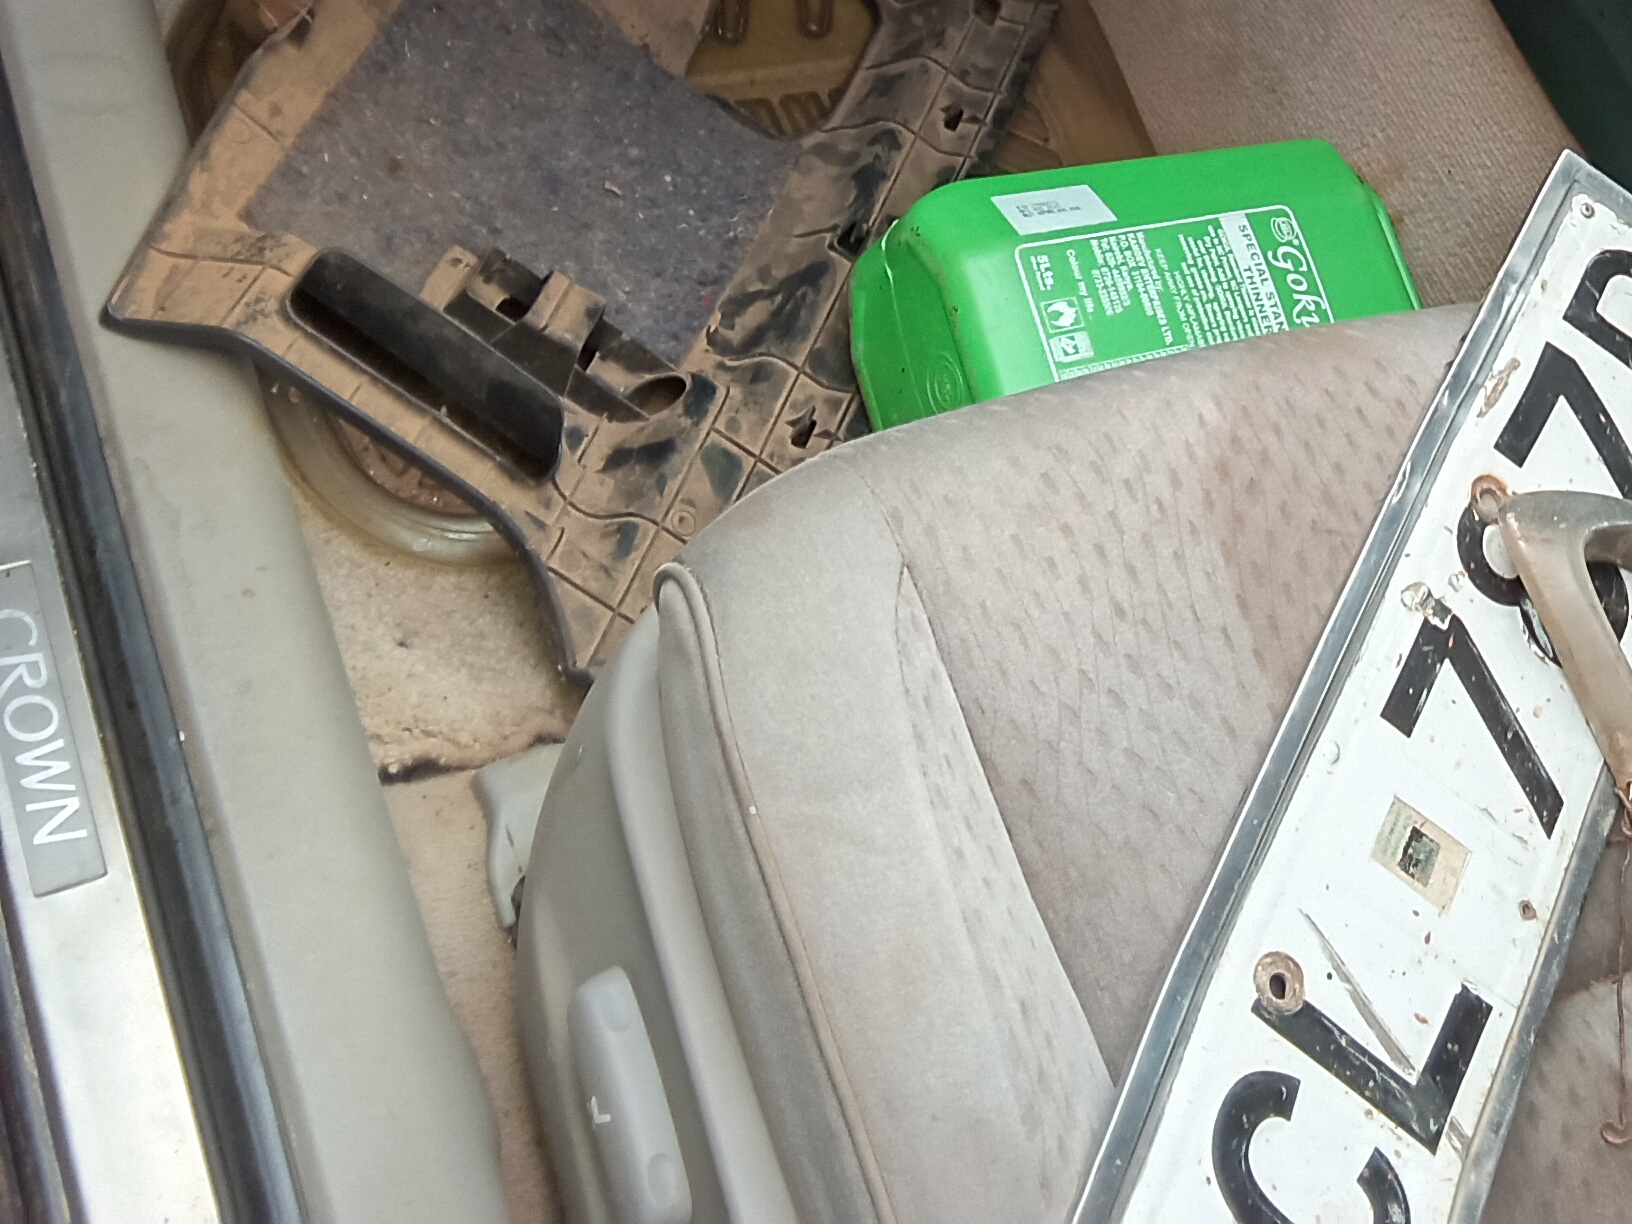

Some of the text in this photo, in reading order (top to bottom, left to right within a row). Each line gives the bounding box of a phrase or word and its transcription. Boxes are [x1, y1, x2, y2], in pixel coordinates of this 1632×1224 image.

[1065, 248, 1083, 280] Colour
[1076, 281, 1088, 296] my
[1123, 250, 1136, 267] BOX
[1237, 224, 1270, 286] SPECIAL
[1242, 265, 1274, 334] THINNER
[0, 608, 88, 845] CROWN
